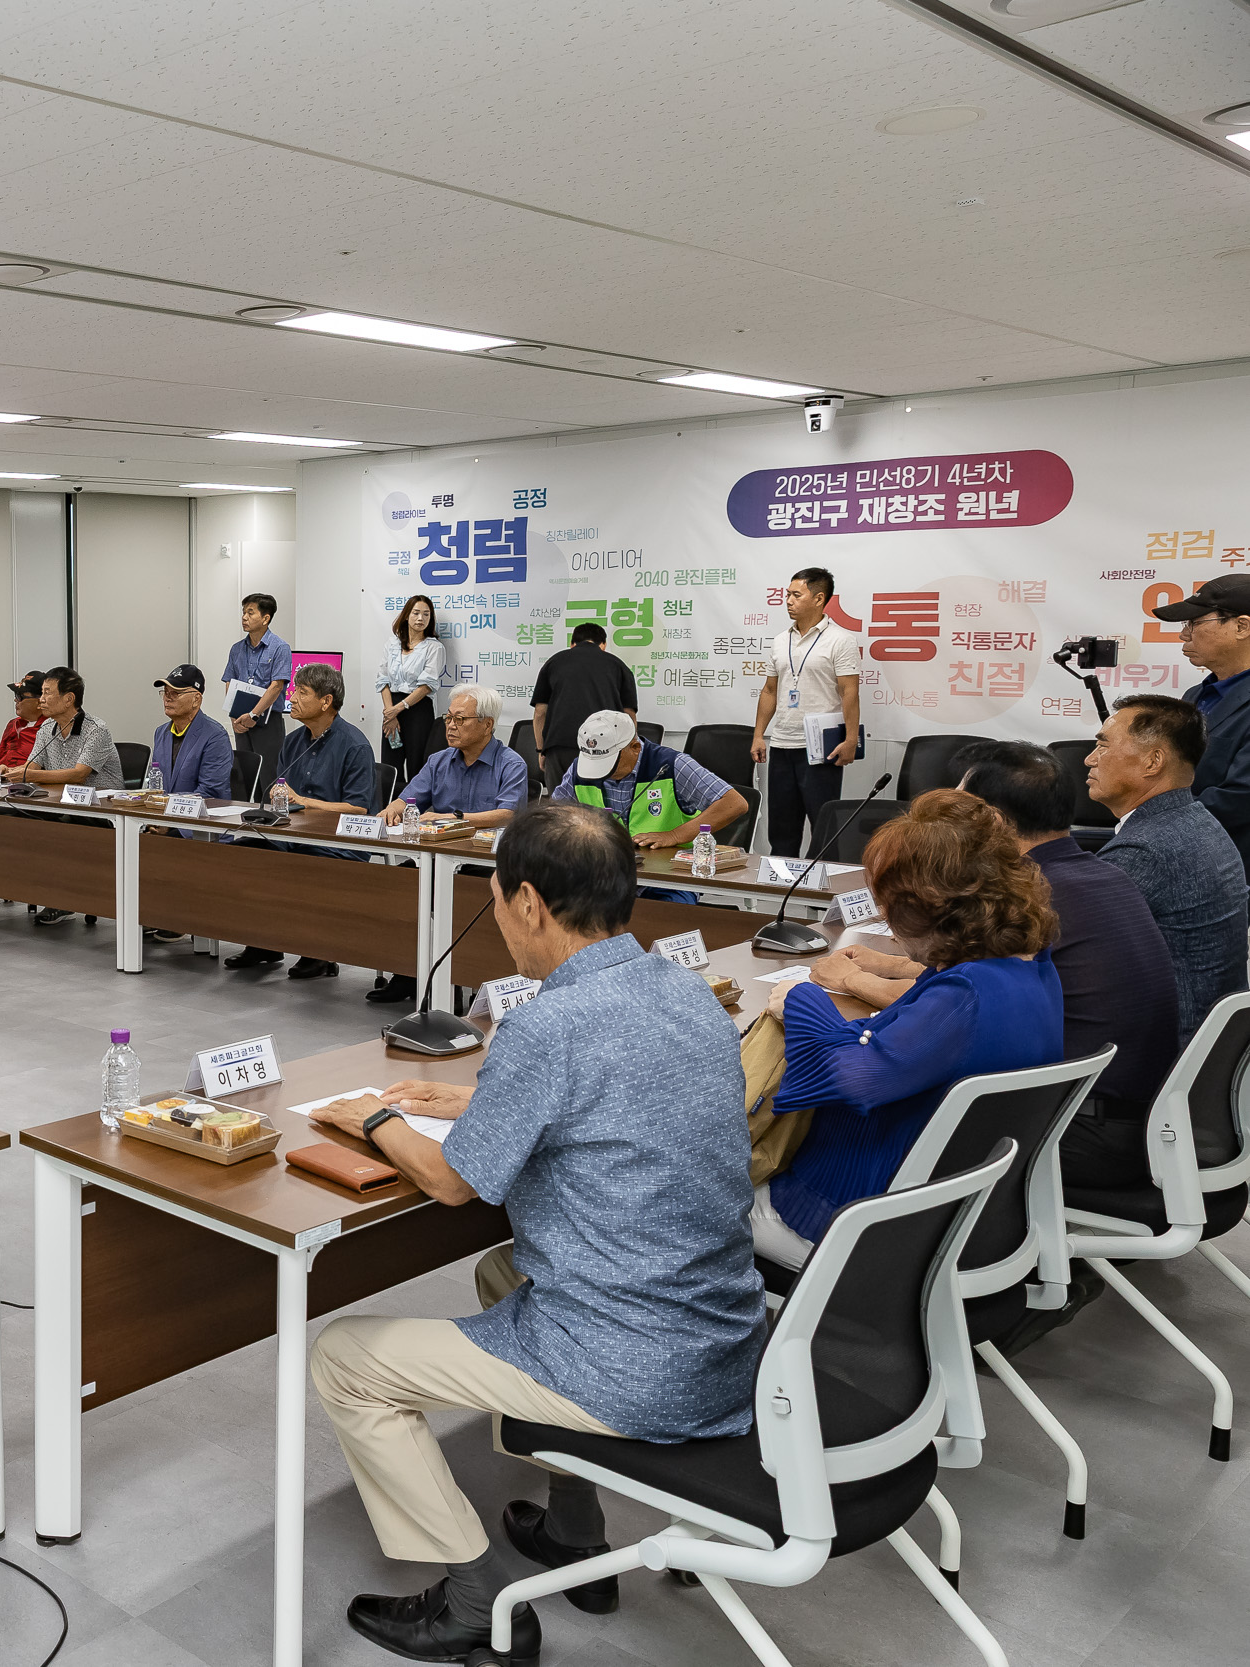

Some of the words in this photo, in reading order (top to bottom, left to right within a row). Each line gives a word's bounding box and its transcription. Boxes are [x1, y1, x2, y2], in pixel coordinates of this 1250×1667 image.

[774, 470, 847, 497] 2025년
[855, 464, 940, 492] 민선8기
[947, 459, 1014, 486] 4년차
[431, 493, 455, 508] 투명
[513, 488, 547, 509] 공정
[391, 509, 426, 520] 청렴라이브
[766, 499, 848, 531] 광진구
[857, 493, 946, 526] 재창조
[955, 488, 1021, 521] 원년
[546, 527, 599, 543] 칭찬릴레이
[417, 516, 528, 586] 청렴
[1145, 529, 1215, 561] 점검
[388, 550, 411, 566] 긍정
[571, 548, 643, 571] 아이디어
[1220, 547, 1250, 568] 주
[634, 570, 669, 588] 2040
[673, 568, 736, 586] 광진플랜
[1099, 569, 1157, 581] 사회안전망
[766, 587, 789, 606] 경
[997, 579, 1047, 604] 해결
[385, 594, 441, 611] 종합도
[444, 593, 487, 609] 2년연속
[491, 592, 521, 608] 1등급
[663, 599, 693, 617] 청년
[954, 603, 983, 618] 현장
[469, 614, 496, 630] 의지
[529, 607, 561, 618] 4차산업
[743, 613, 769, 626] 배려
[1141, 581, 1211, 644] 안
[435, 622, 468, 640] 킴이
[516, 623, 555, 645] 창출
[662, 628, 692, 640] 재창조
[951, 631, 1037, 651] 직통문자
[478, 651, 532, 667] 부패방지
[632, 664, 657, 688] 장
[663, 668, 736, 689] 예술문화
[948, 660, 1025, 698] 친절
[1094, 663, 1180, 689] 비우기
[656, 695, 686, 706] 현대화
[872, 690, 940, 708] 의사소통
[1041, 697, 1082, 717] 연결
[345, 824, 372, 835] 박기수
[210, 1044, 263, 1063] 세종파크골프회
[217, 1060, 267, 1088] 이차영
